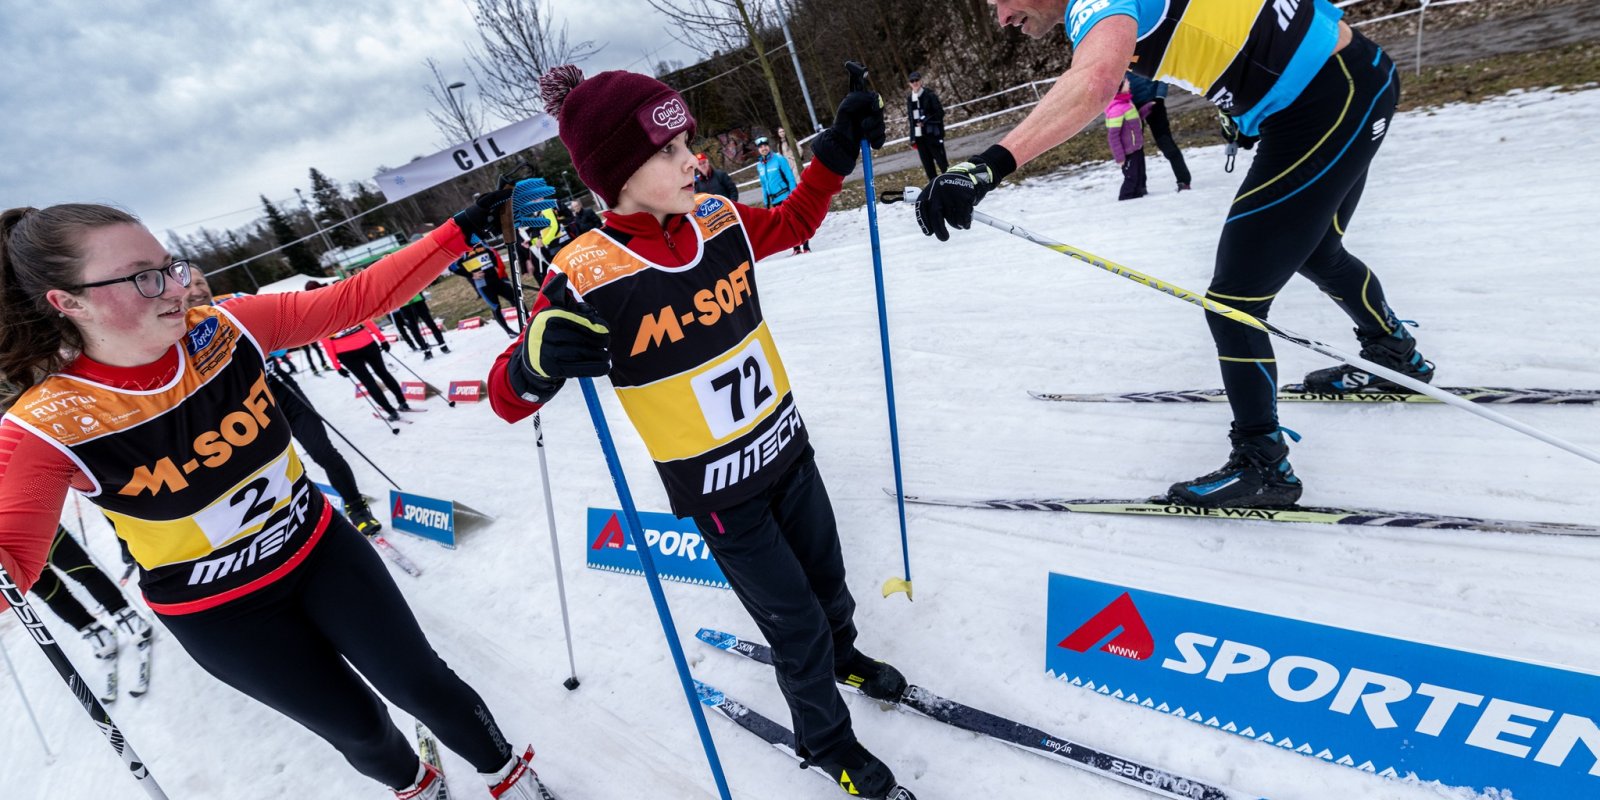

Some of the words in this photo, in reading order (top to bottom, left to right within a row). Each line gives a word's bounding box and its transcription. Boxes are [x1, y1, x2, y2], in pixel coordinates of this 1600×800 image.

[452, 137, 506, 171] CÍL
[700, 199, 721, 216] Ford
[630, 261, 752, 358] M-SOFT
[189, 323, 214, 352] Ford
[710, 355, 773, 423] 72
[118, 368, 276, 497] M-SOFT
[229, 476, 277, 529] 2
[403, 504, 450, 531] SPORTEN
[736, 641, 756, 653] SKIN
[1107, 643, 1141, 660] www.
[1161, 631, 1600, 778] SPORTEN
